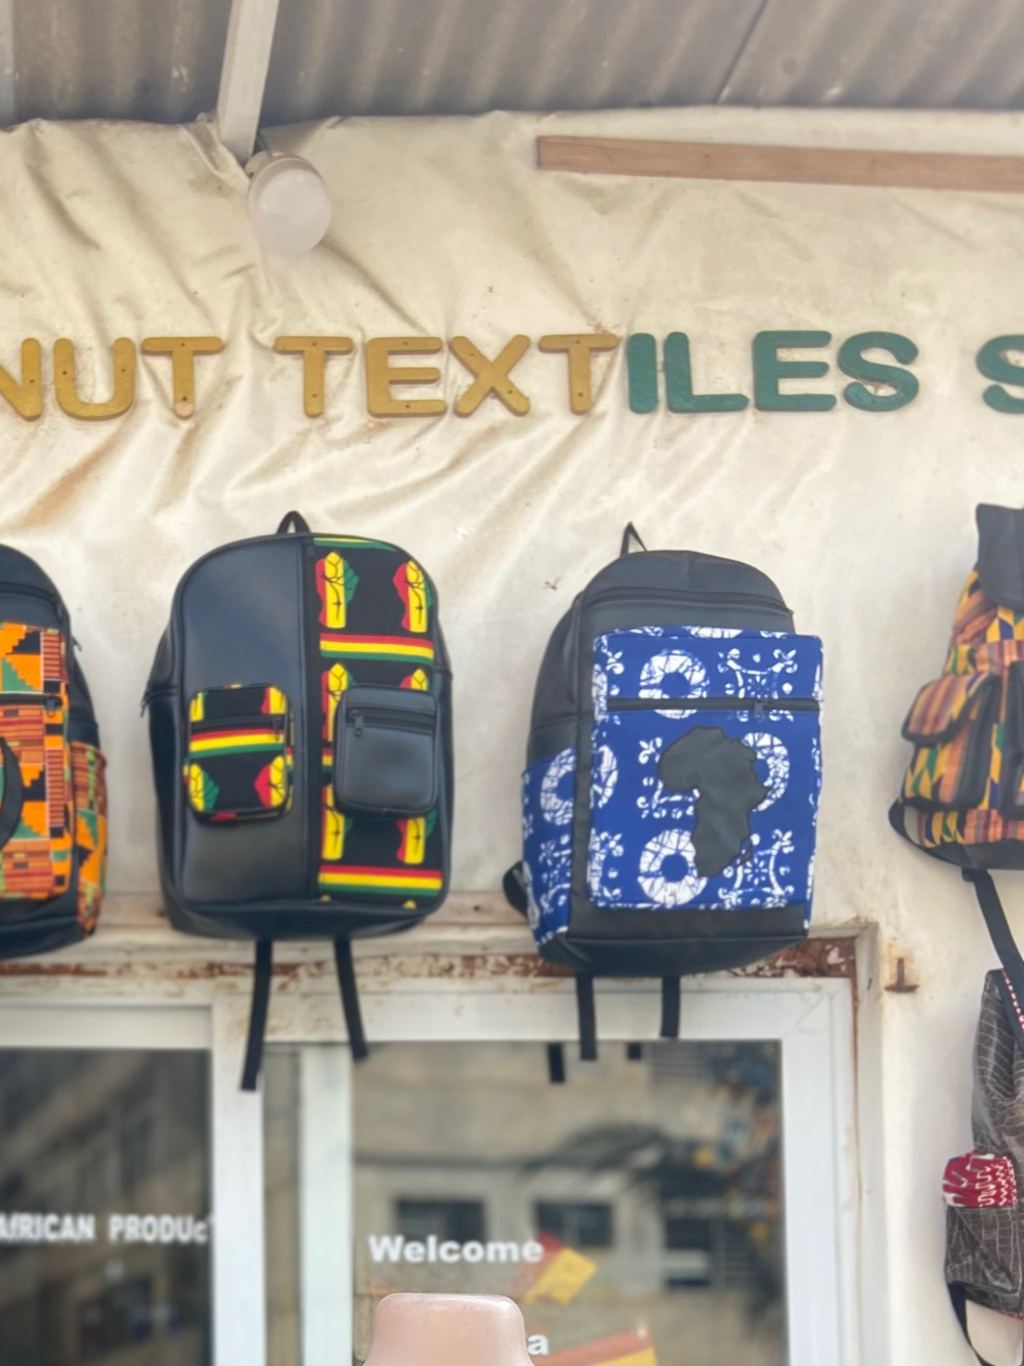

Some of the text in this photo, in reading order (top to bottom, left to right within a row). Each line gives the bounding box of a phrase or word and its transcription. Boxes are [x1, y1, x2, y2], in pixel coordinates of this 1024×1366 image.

[274, 330, 920, 419] TEXTILES
[108, 1213, 213, 1243] PRODUc
[369, 1235, 544, 1264] Welcome
